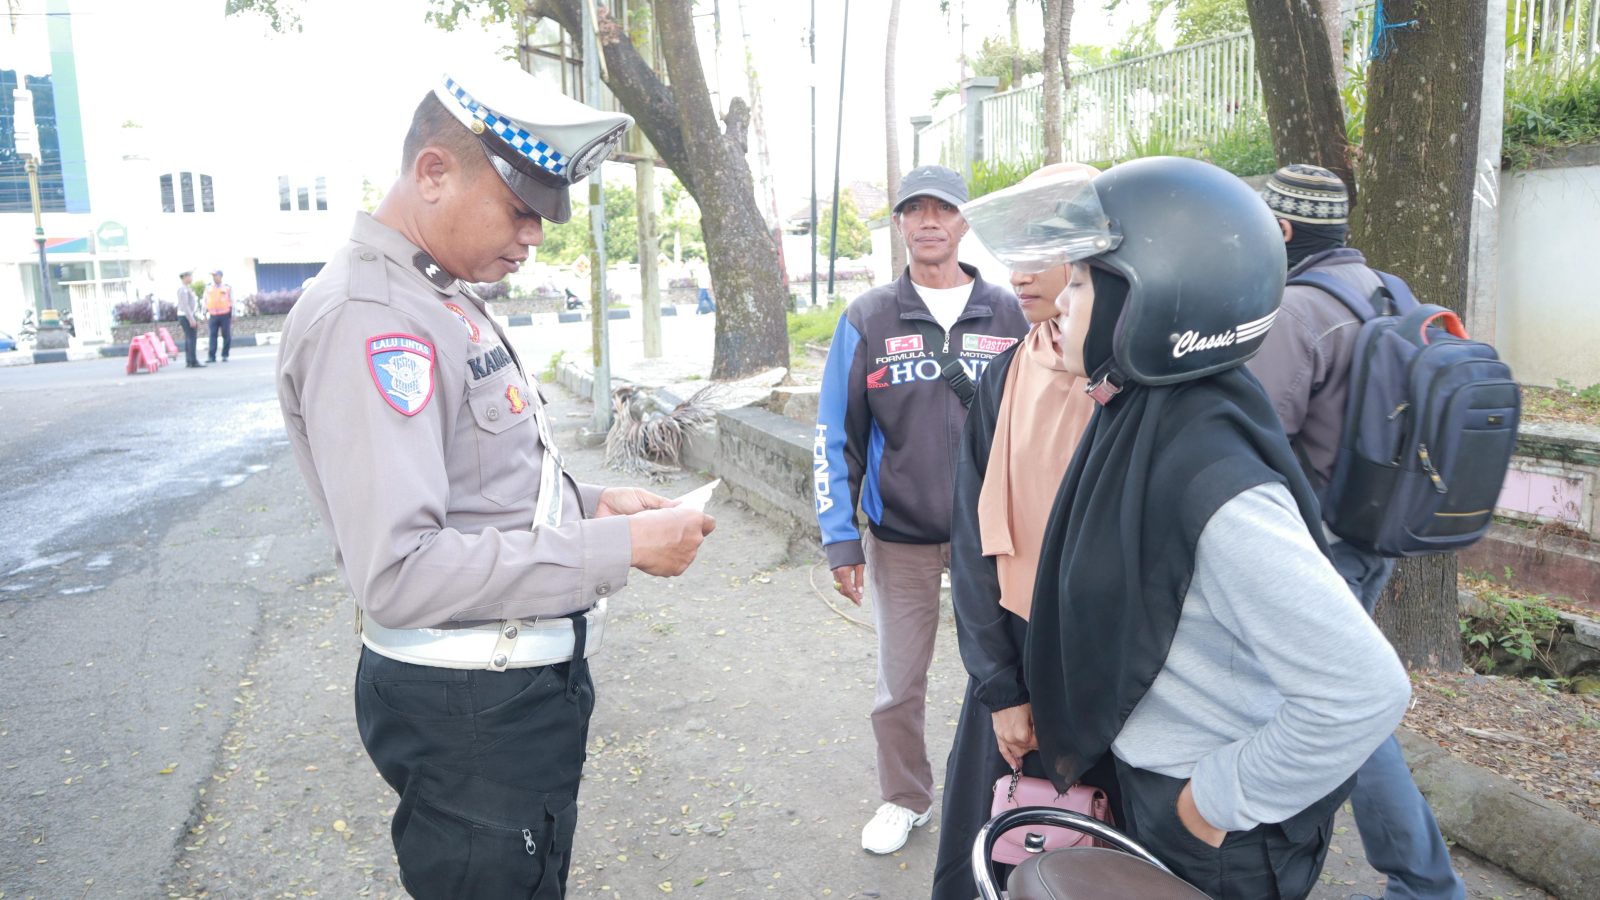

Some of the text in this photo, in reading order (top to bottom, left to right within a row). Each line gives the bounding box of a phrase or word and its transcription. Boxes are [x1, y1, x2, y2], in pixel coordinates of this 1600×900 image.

[373, 337, 430, 355] LALU LINTAS
[890, 337, 919, 352] F-1
[1173, 330, 1236, 358] Classic
[875, 351, 927, 365] FORMULA
[813, 423, 834, 514] HONDA
